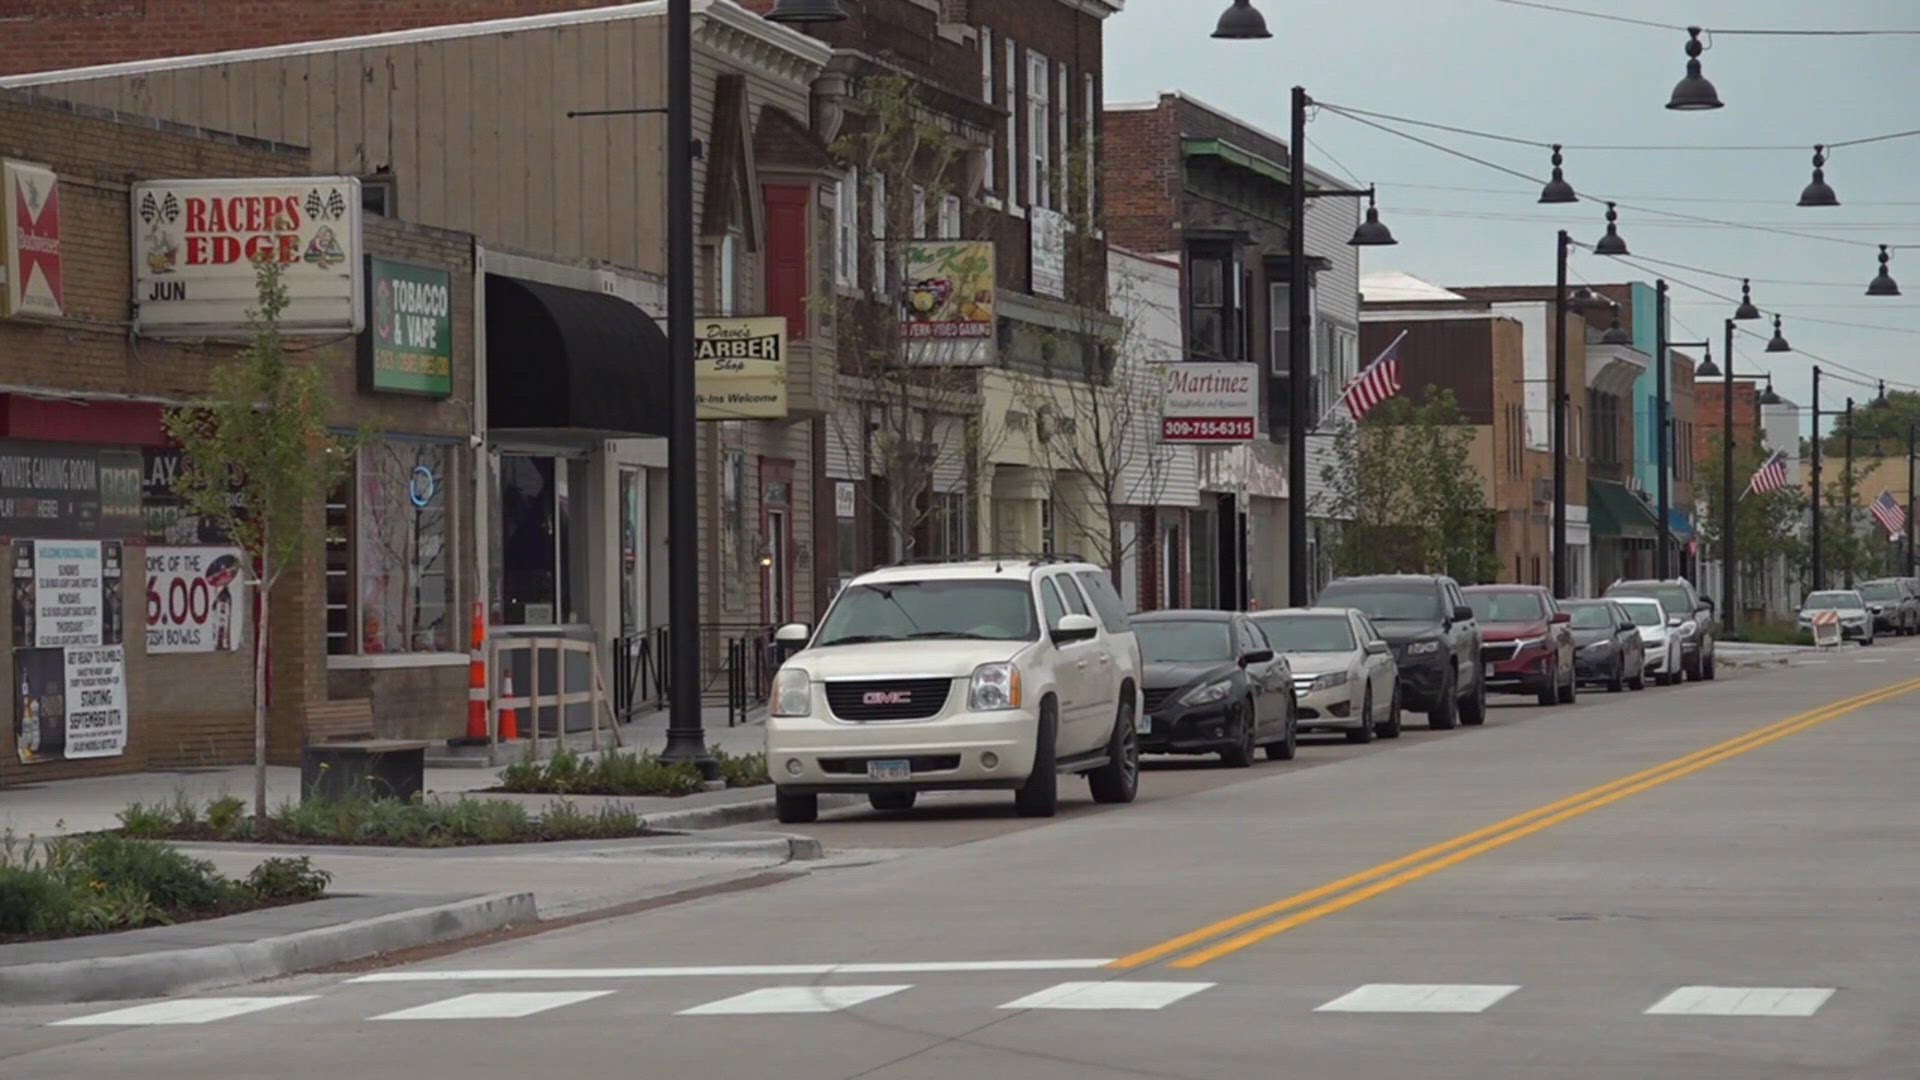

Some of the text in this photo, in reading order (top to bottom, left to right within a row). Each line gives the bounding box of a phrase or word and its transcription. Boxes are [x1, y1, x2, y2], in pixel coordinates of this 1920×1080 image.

[185, 234, 301, 265] EDGE
[150, 282, 186, 301] JUN
[392, 279, 448, 318] TOBACCO
[394, 313, 437, 349] & VAPE
[706, 324, 751, 339] Dave's
[959, 322, 992, 336] GAMING
[695, 336, 777, 359] ARBER
[714, 360, 744, 372] Shop
[1167, 369, 1249, 394] Martinez
[727, 393, 778, 403] Welcome
[1165, 422, 1252, 436] 309-755-6315
[71, 458, 96, 491] ROOM
[168, 555, 181, 572] OF
[184, 554, 201, 572] THE
[167, 629, 201, 646] BOWLS
[81, 690, 111, 707] STARTING
[863, 691, 911, 704] GMC
[70, 711, 106, 729] SEPTEMBER
